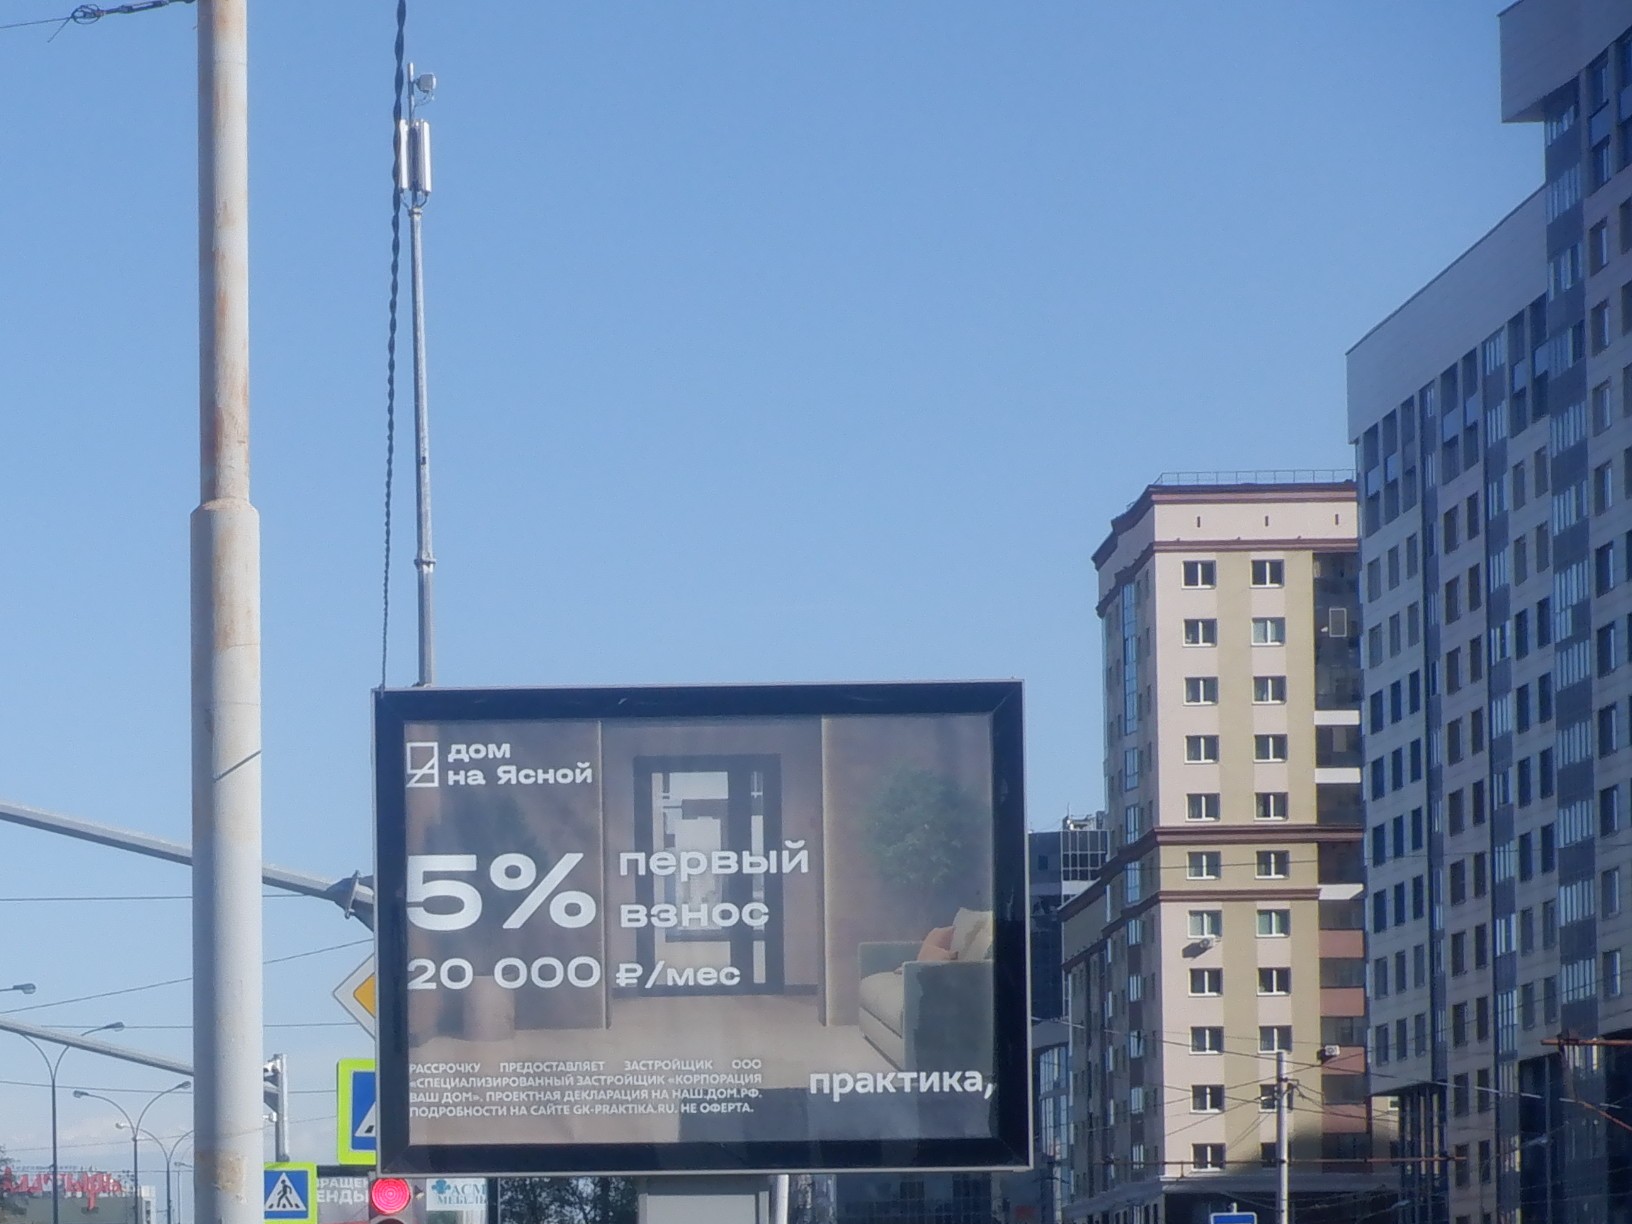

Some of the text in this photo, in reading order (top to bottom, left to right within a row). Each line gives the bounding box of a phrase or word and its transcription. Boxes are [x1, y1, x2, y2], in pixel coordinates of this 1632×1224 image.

[448, 741, 511, 763] дом
[448, 761, 593, 786] на Ясной
[619, 841, 811, 881] первый
[407, 853, 597, 931] 5%
[619, 902, 770, 928] взнос
[407, 956, 742, 990] 20 000 ₽/мес
[409, 1059, 762, 1074] РАССРОЧКУ ПРЕДОСТАВЛЯЕТ ЗАСТРОЙЩИК ООО
[577, 1074, 665, 1086] ЗАСТРОЙЩИК
[809, 1068, 998, 1101] практика,
[409, 1092, 440, 1103] ВАШ
[486, 1091, 561, 1102] ПРОЕКТНАЯ
[563, 1089, 649, 1102] ДЕКЛАРАЦИЯ
[651, 1090, 669, 1099] НА
[409, 1106, 507, 1119] ПОДРОБНОСТИ
[510, 1105, 528, 1116] НА
[530, 1104, 569, 1115] САЙТЕ
[680, 1103, 697, 1113] НЕ
[700, 1102, 755, 1113] ОФЕРТА.
